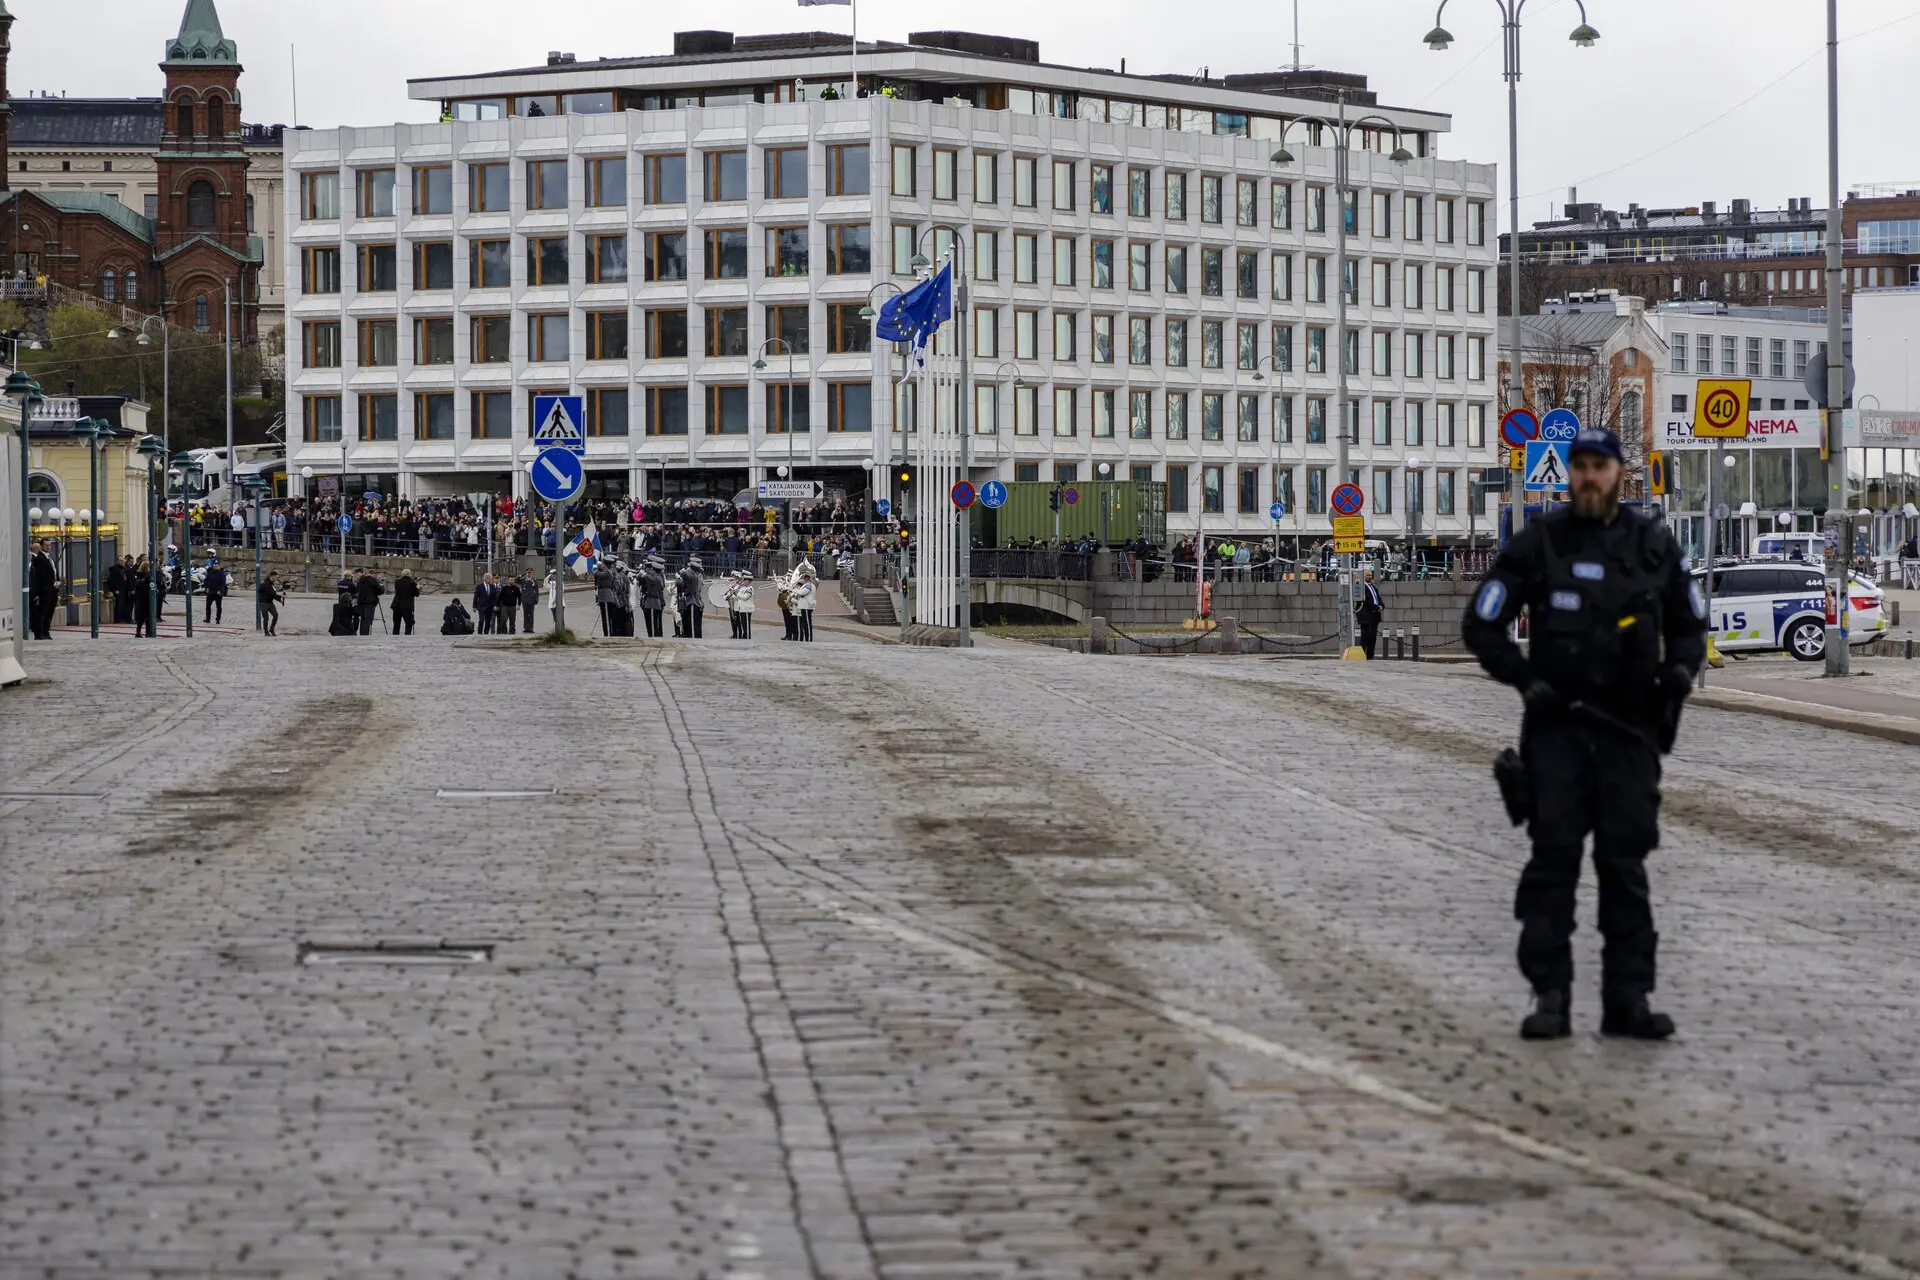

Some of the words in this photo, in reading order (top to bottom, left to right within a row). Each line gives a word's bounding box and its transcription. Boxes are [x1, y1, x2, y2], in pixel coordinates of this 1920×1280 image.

[1711, 399, 1733, 418] 40
[1667, 421, 1695, 436] FLY
[1747, 419, 1799, 434] NEMA
[1708, 611, 1747, 632] LIS
